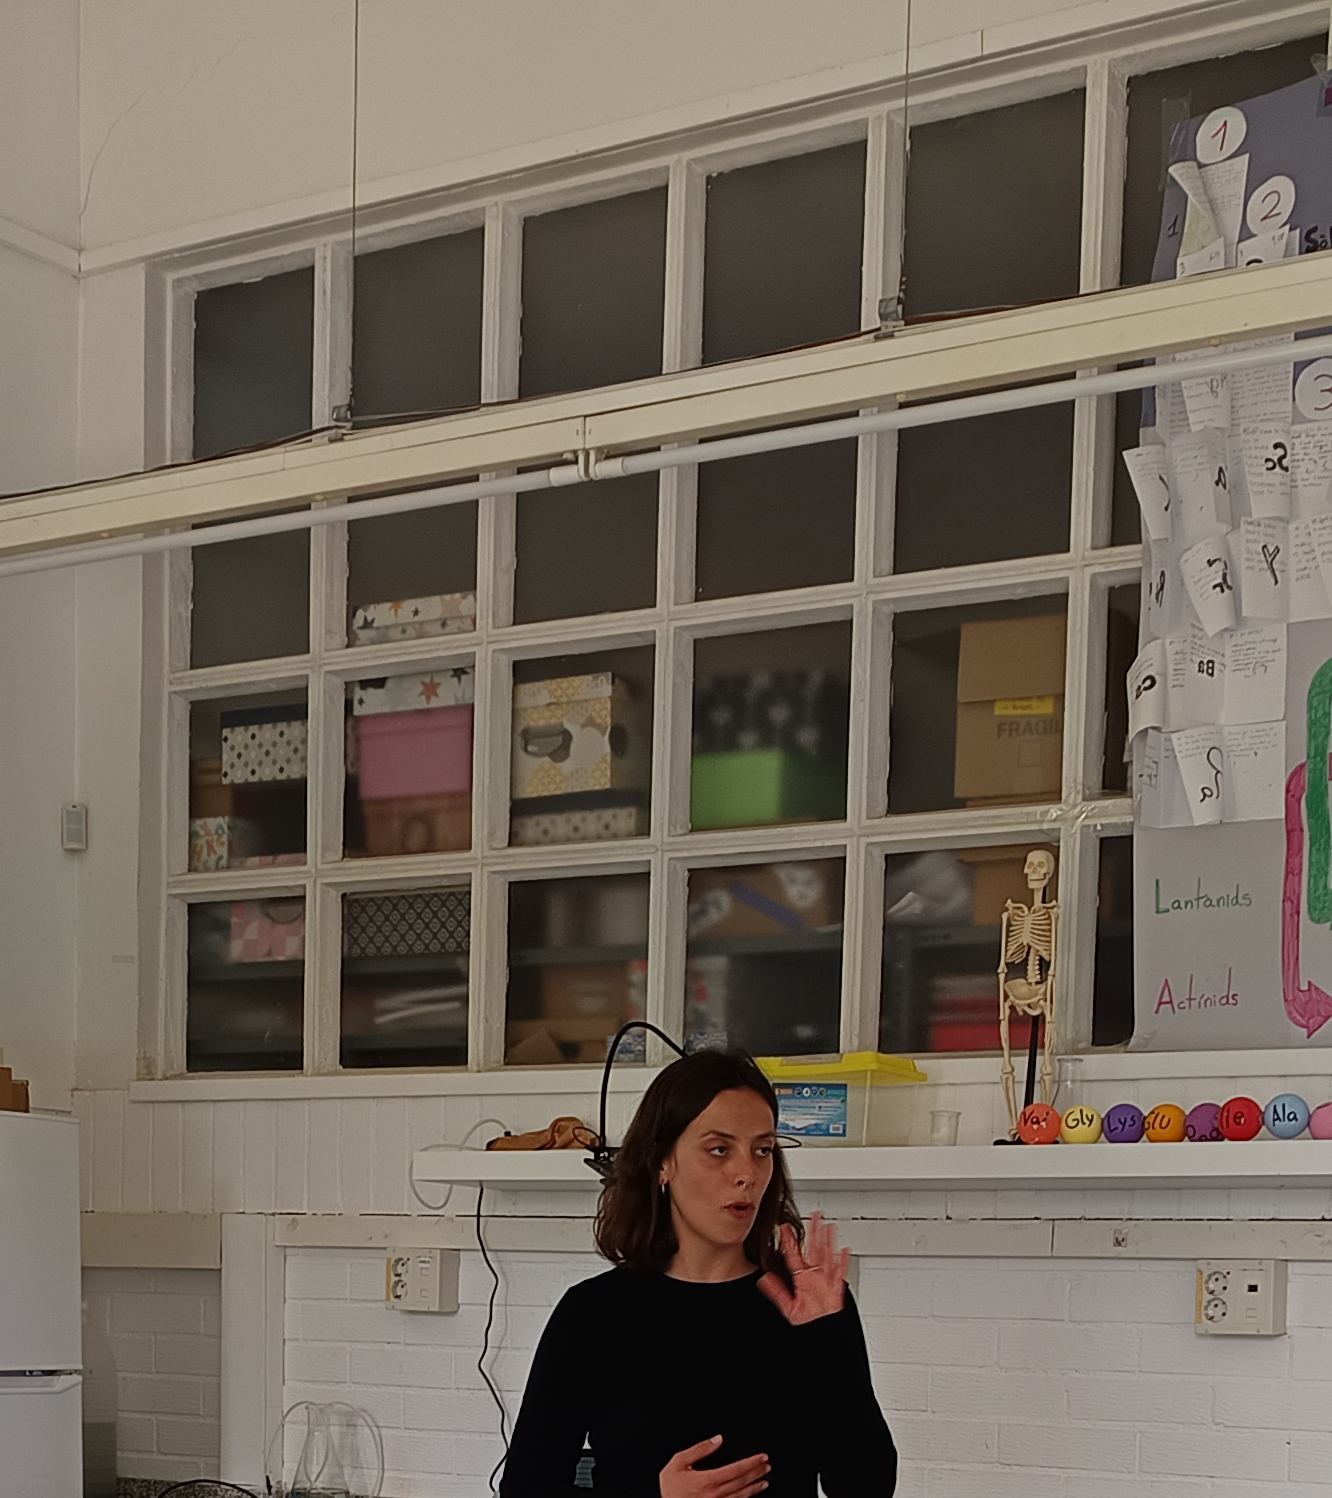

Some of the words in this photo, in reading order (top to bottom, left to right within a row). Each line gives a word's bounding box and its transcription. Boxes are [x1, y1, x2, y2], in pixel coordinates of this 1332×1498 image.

[1213, 119, 1228, 152] 1
[1260, 190, 1282, 222] 2
[1064, 1110, 1095, 1130] Gly
[1107, 1114, 1137, 1133] Lys
[1272, 1103, 1299, 1124] Ala
